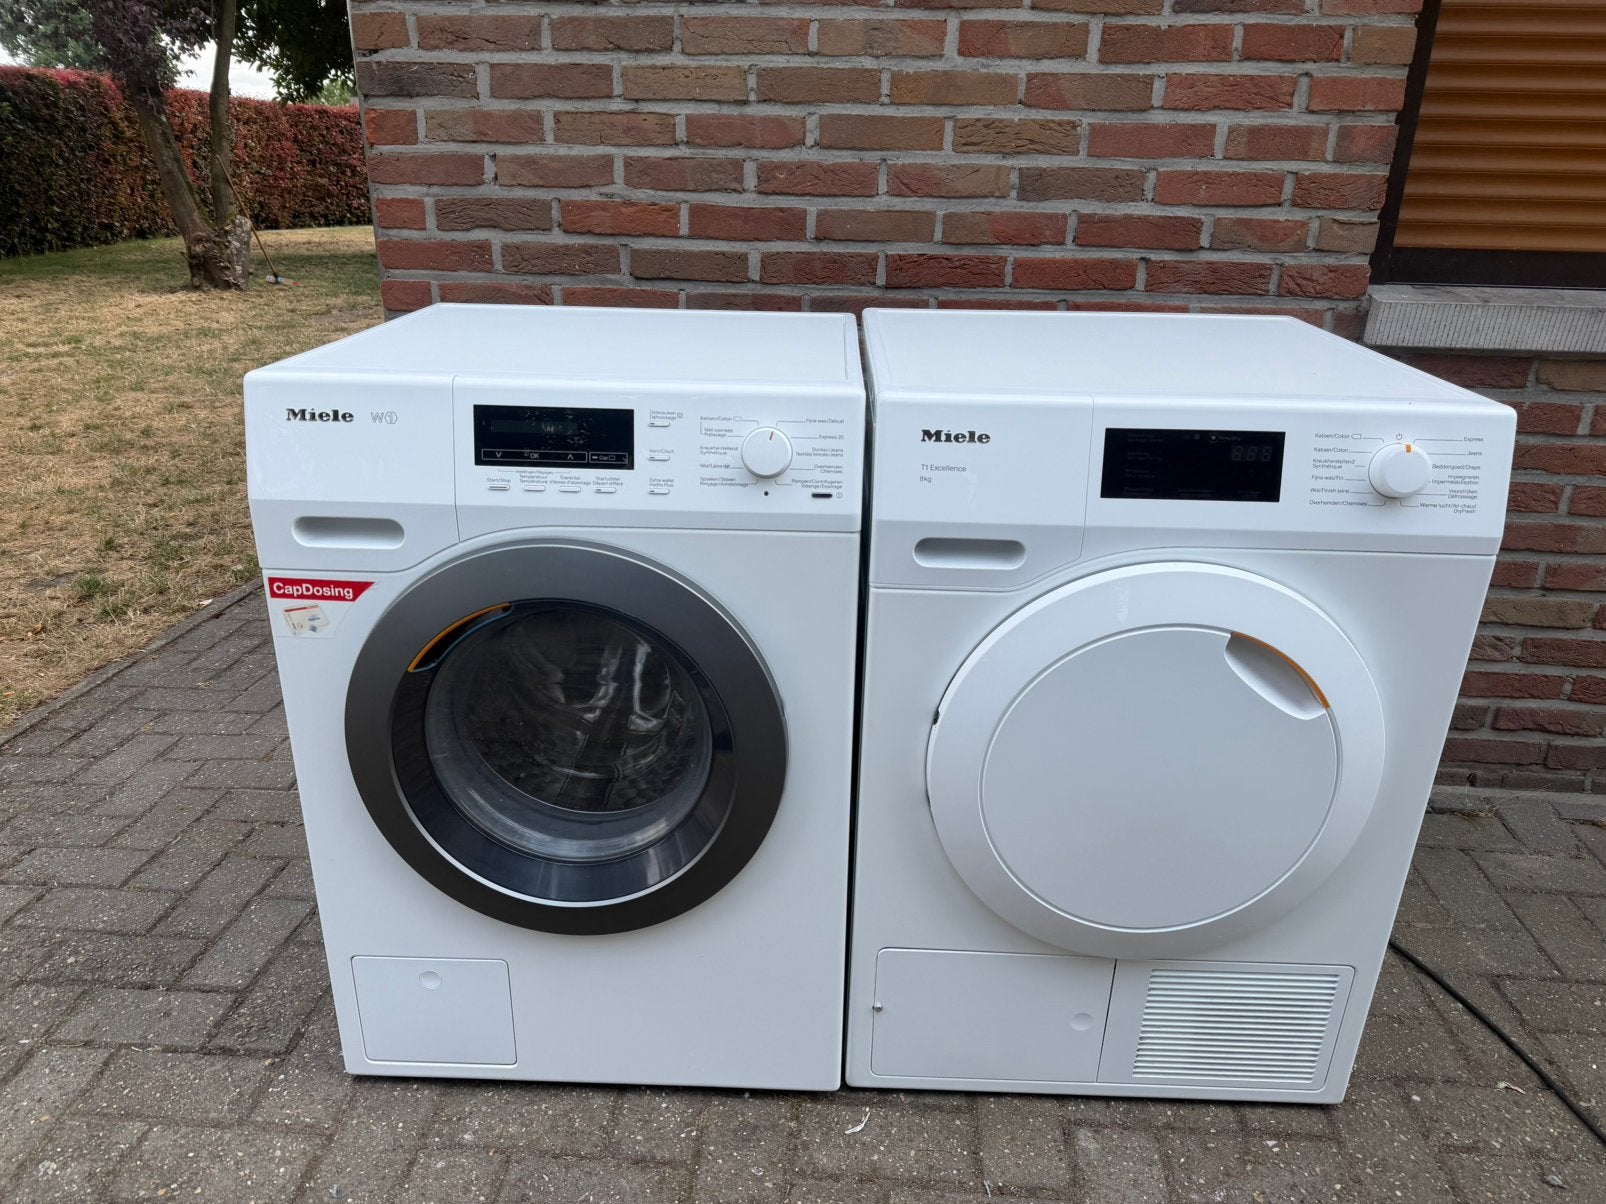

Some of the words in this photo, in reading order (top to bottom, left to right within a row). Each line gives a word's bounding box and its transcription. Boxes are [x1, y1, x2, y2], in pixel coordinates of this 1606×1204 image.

[285, 408, 354, 422] Miele
[921, 429, 991, 444] Miele
[930, 464, 967, 472] Excellence
[273, 582, 353, 599] CapDosing
